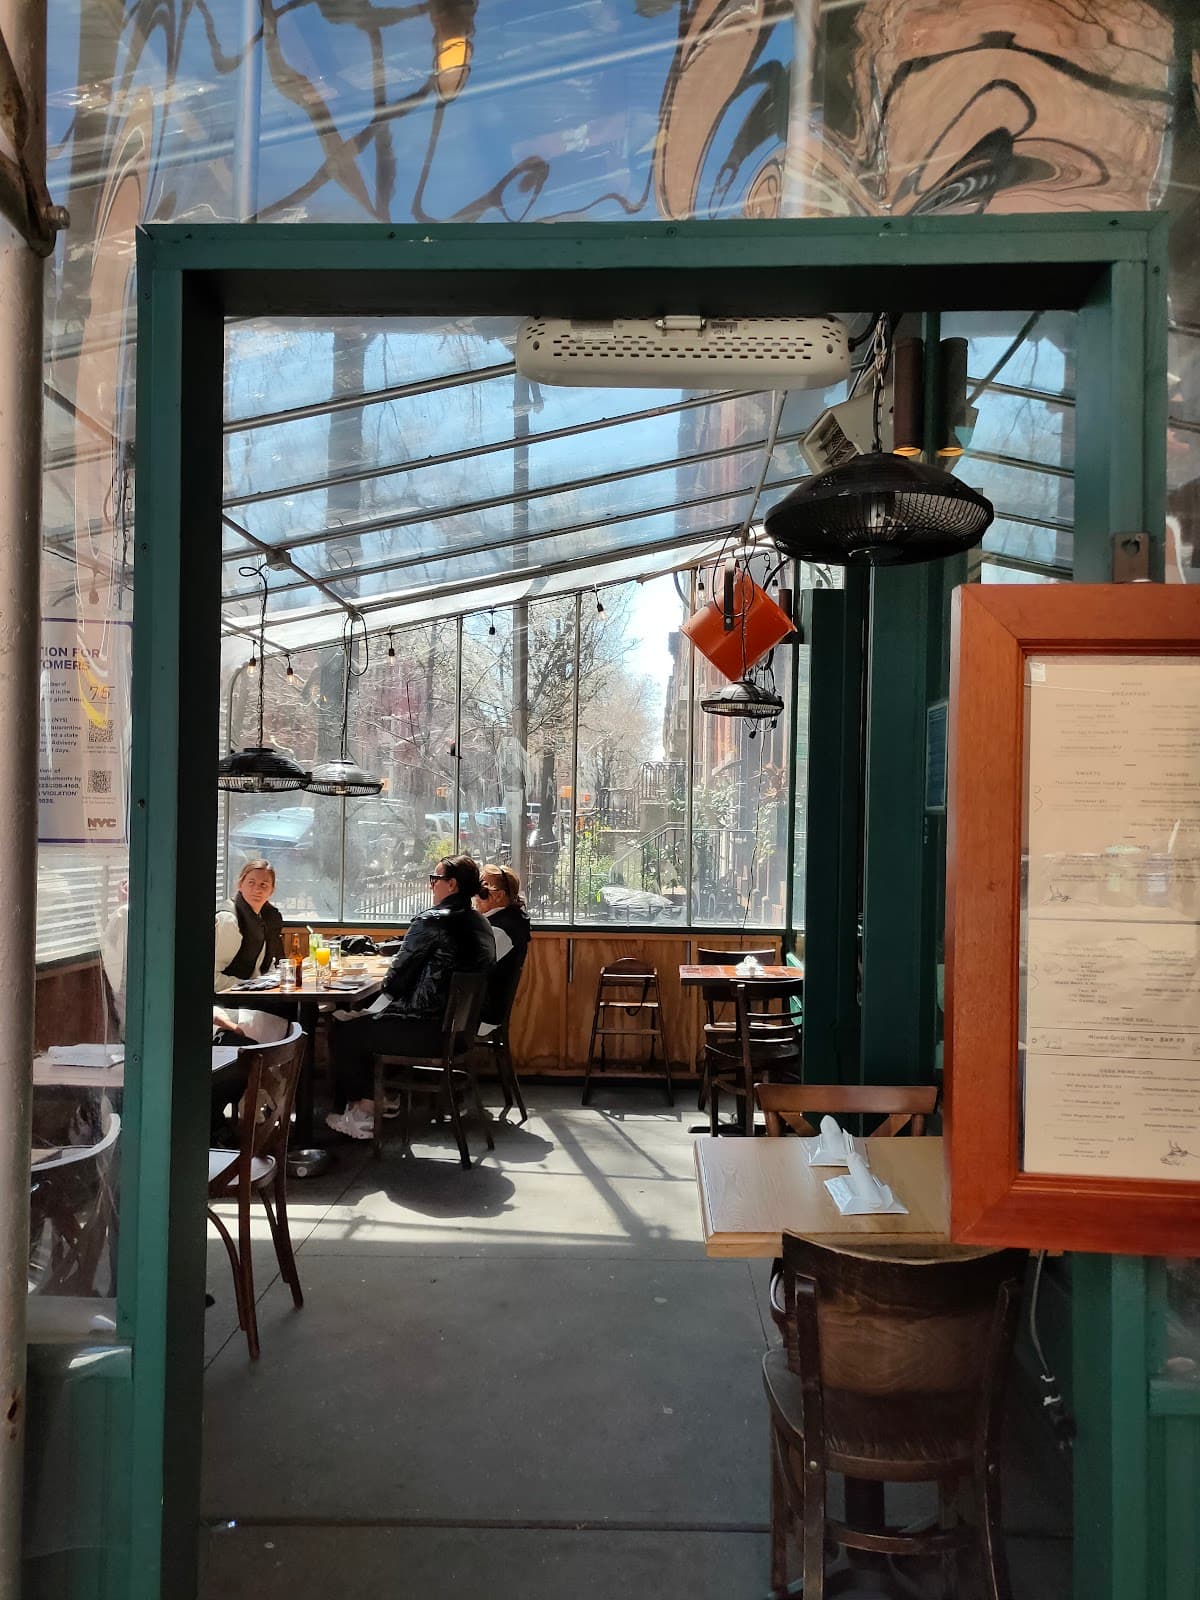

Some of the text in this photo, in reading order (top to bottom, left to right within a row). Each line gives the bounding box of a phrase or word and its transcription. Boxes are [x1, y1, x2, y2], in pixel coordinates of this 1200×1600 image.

[72, 647, 101, 659] FOR
[40, 659, 90, 670] OMERS
[88, 817, 117, 828] NYC
